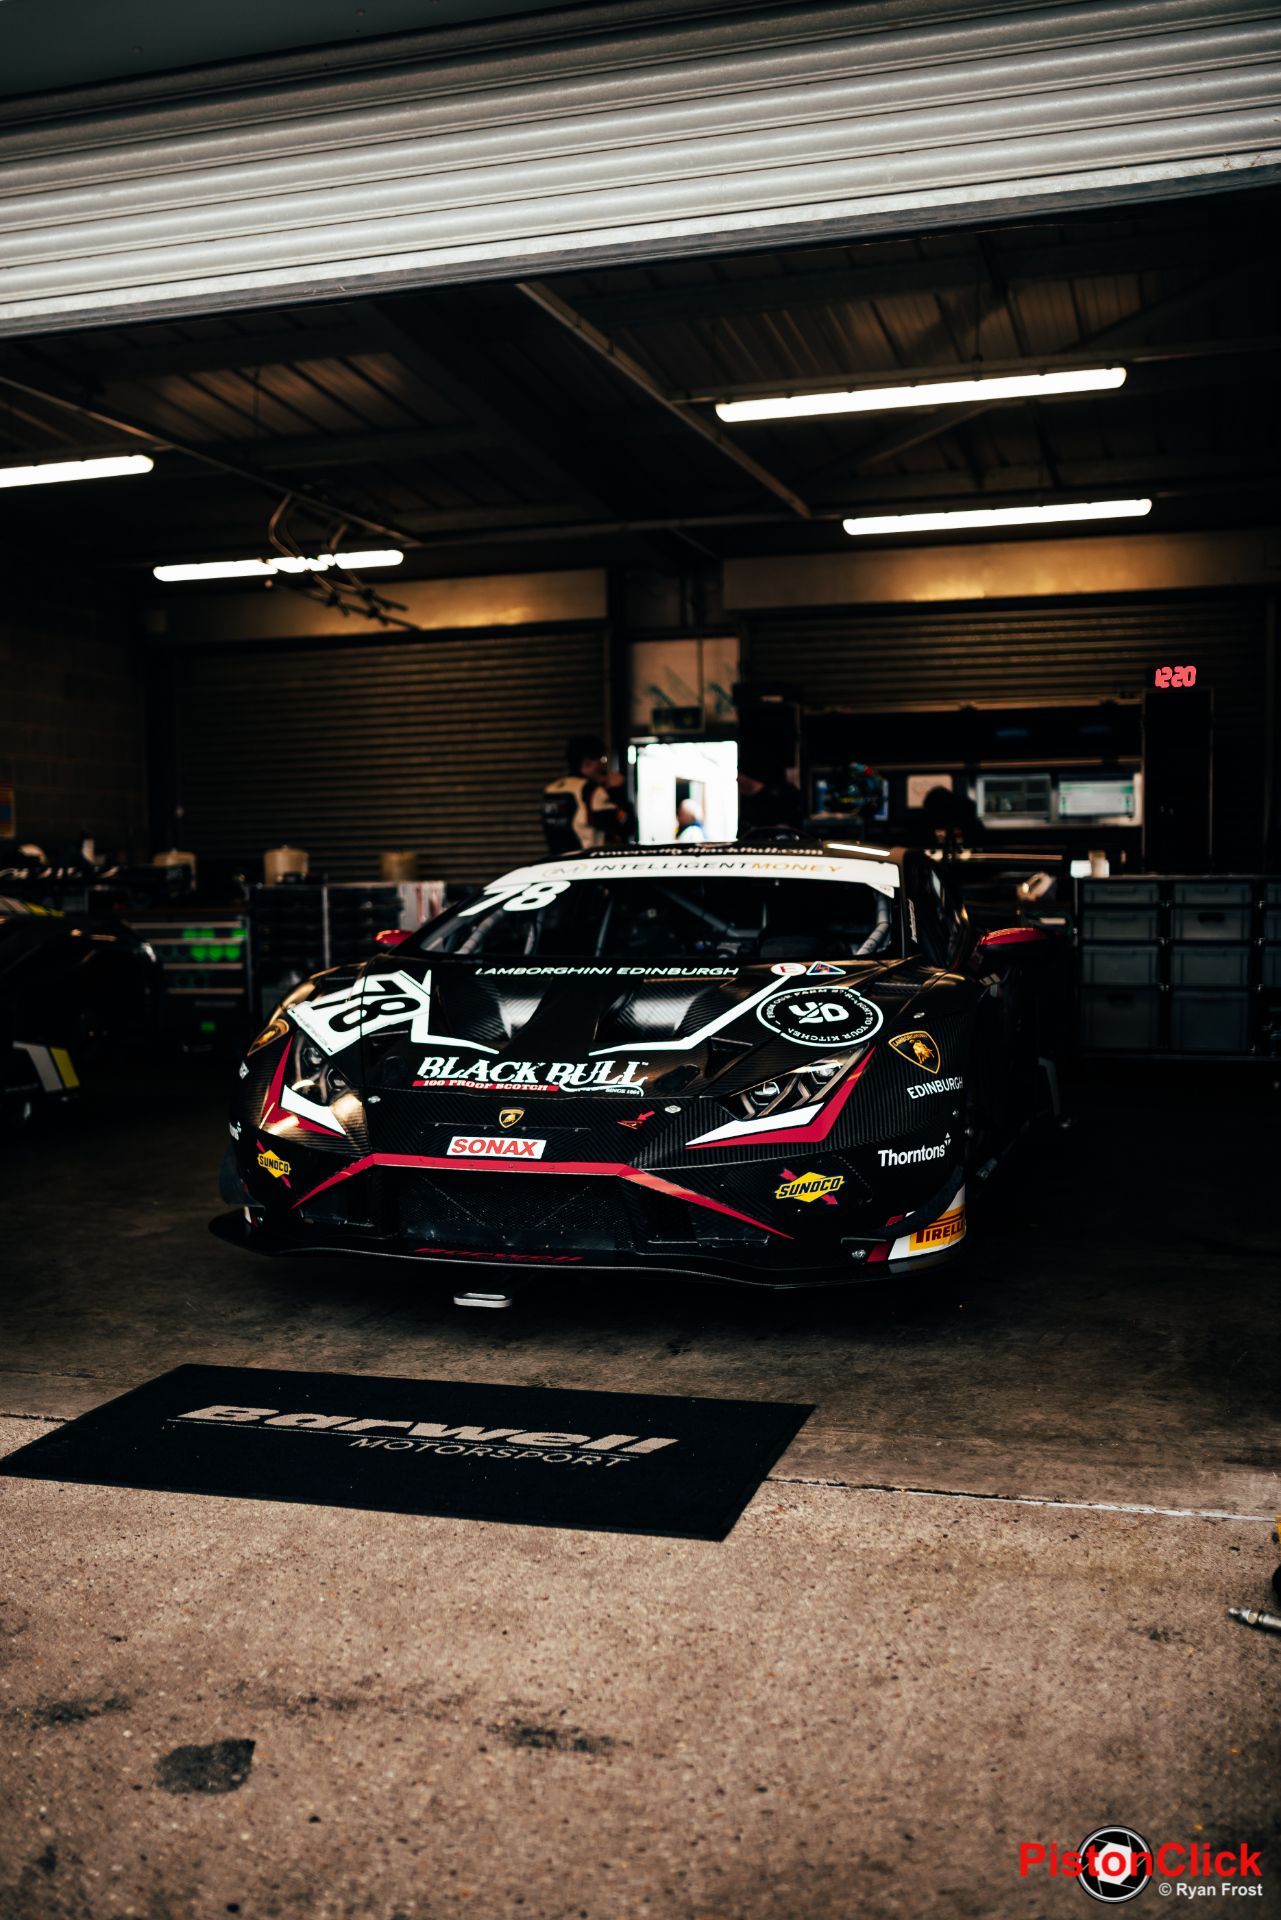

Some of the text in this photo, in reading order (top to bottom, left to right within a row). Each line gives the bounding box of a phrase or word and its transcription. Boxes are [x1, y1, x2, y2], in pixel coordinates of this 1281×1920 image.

[457, 881, 572, 917] 78
[475, 966, 740, 976] LAMBORGHINI EDINBURGH
[311, 980, 421, 1032] 78
[416, 1056, 649, 1088] BLACK BULL
[423, 1079, 549, 1091] 100 PROOF SCOTCH
[906, 1076, 963, 1099] EDINBURGH
[451, 1138, 538, 1156] SONAX
[877, 1144, 946, 1167] Thorntons
[259, 1155, 289, 1174] SUNOCO
[779, 1177, 842, 1197] SUNOCO
[177, 1404, 680, 1454] Barwell
[350, 1436, 631, 1467] MOTORSPORT
